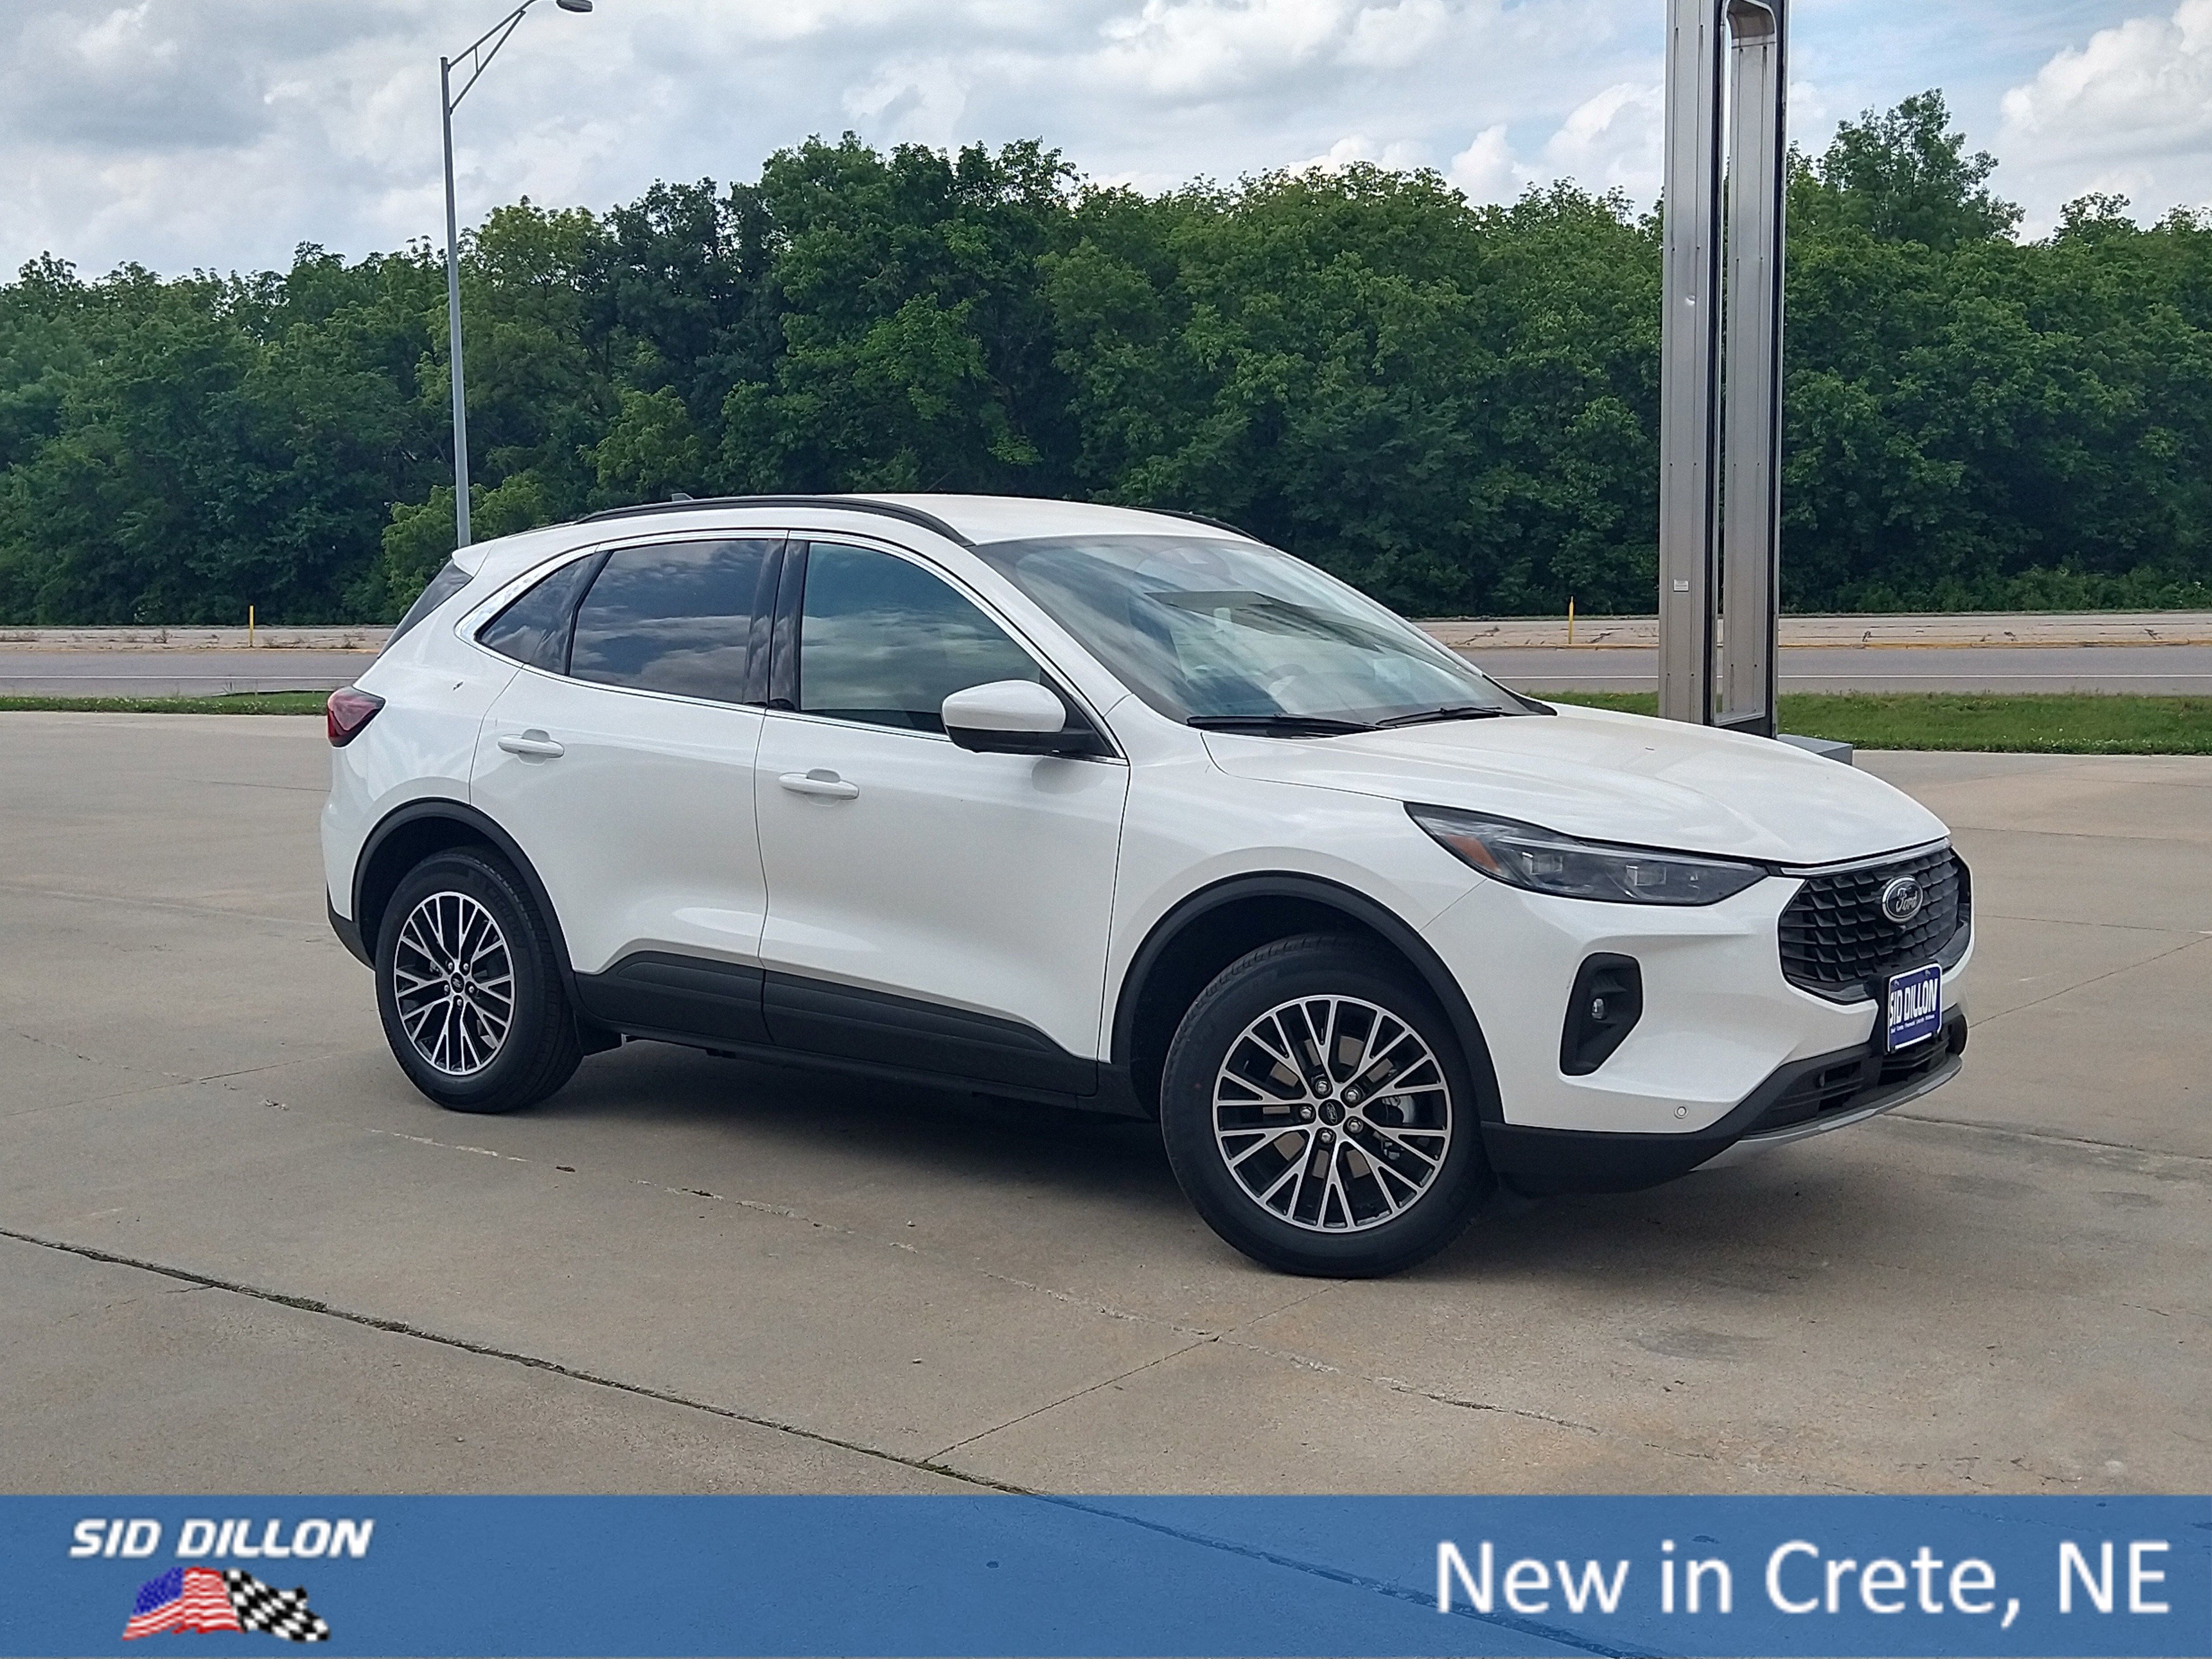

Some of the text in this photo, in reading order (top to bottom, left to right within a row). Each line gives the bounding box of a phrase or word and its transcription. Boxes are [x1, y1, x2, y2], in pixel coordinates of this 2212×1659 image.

[1896, 888, 1918, 912] Ford
[1890, 989, 1902, 1026] SID
[1903, 978, 1938, 1021] DILLON
